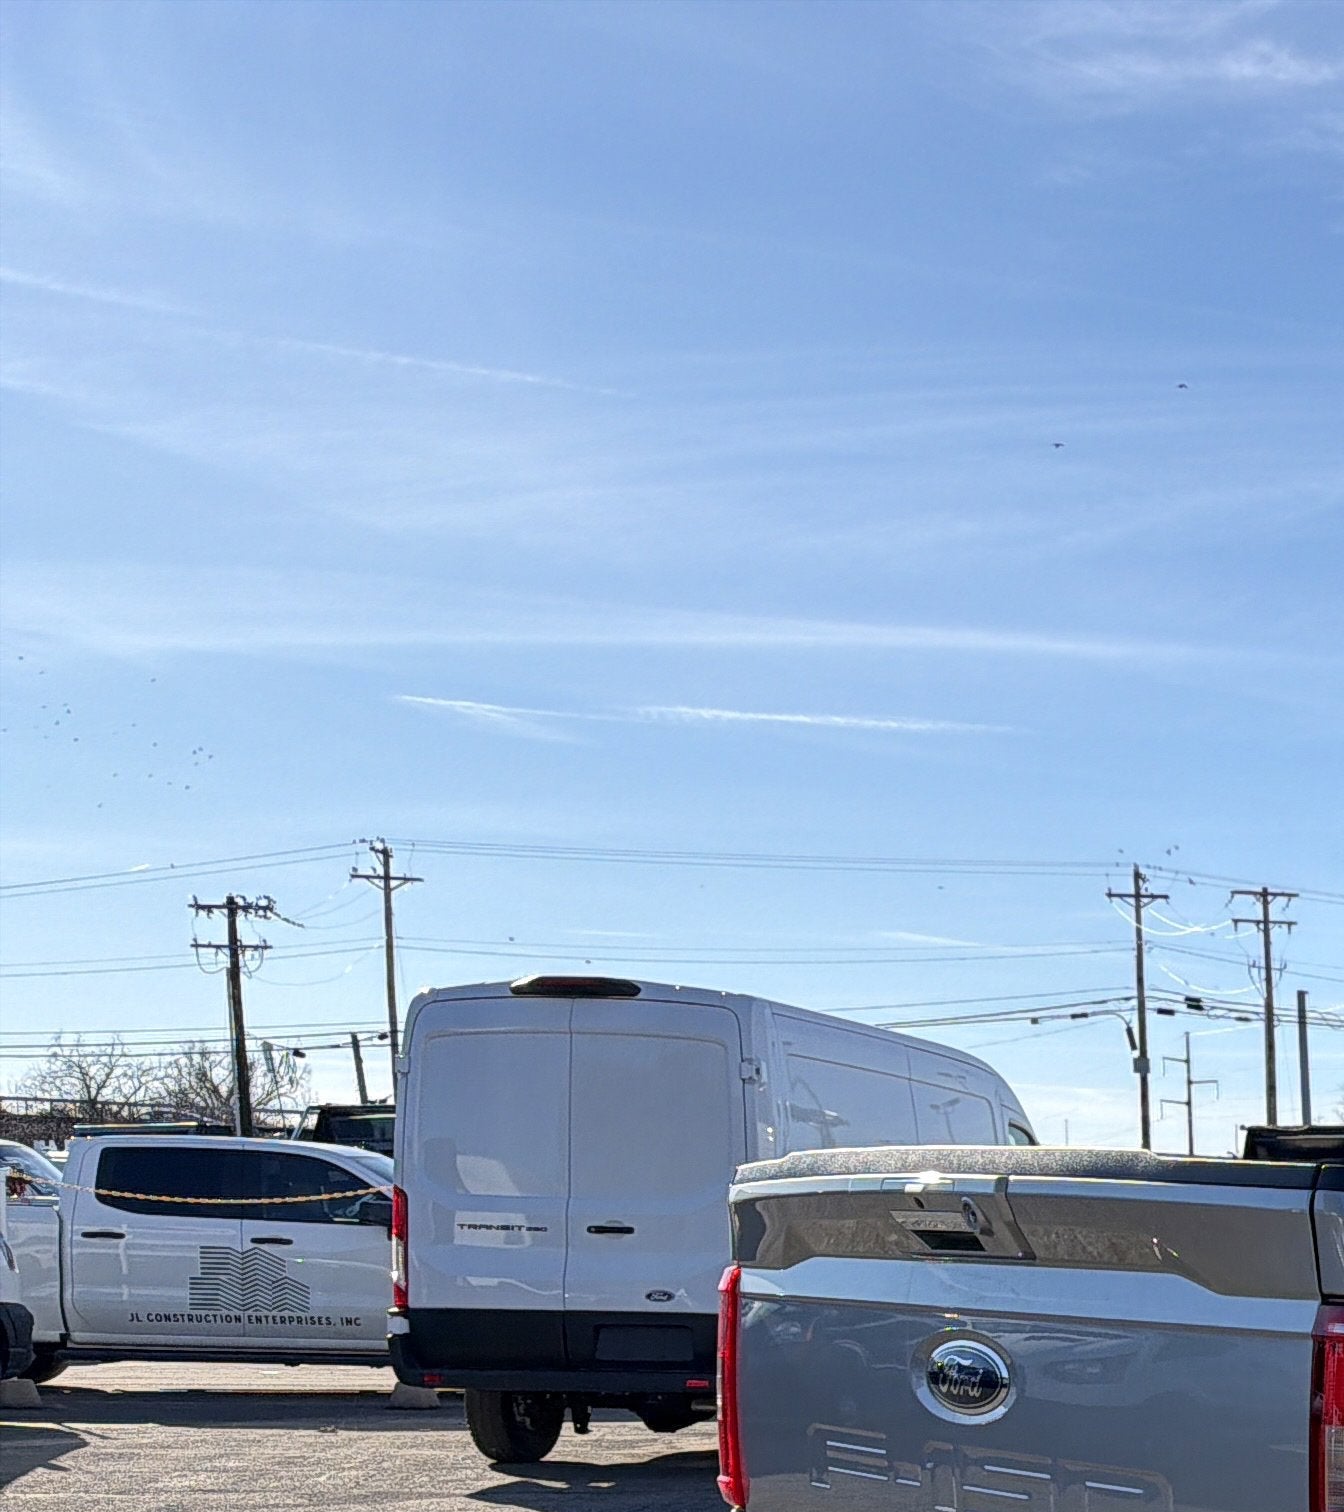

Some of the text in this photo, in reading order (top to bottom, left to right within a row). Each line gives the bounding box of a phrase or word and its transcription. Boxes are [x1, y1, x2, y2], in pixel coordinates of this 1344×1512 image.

[456, 1223, 525, 1231] TRANSIT
[128, 1312, 143, 1323] JL
[146, 1312, 242, 1324] CONSTRUCTION
[340, 1316, 362, 1327] INC
[938, 1354, 983, 1399] Ford
